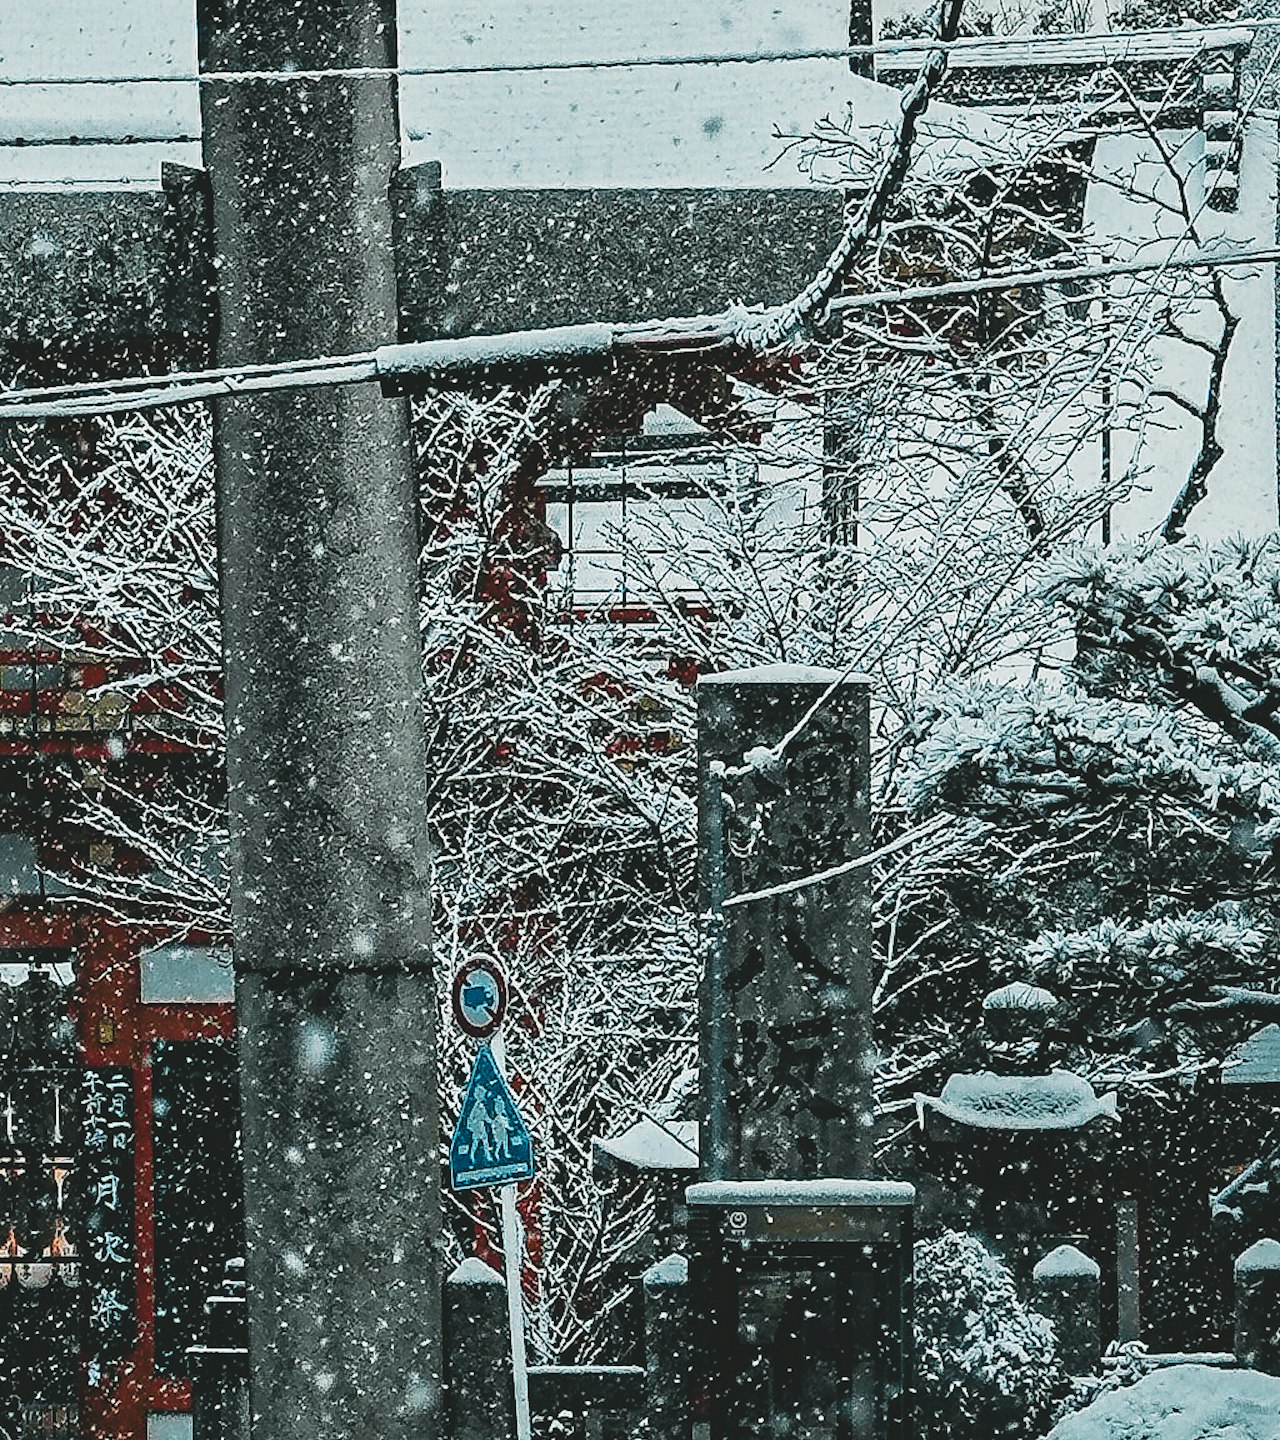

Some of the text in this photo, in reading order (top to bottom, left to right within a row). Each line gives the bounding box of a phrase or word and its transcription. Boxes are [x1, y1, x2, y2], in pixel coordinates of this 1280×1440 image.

[81, 1070, 108, 1153] 午前十時
[106, 1074, 132, 1150] 二月一日
[89, 1175, 130, 1329] 月次祭
